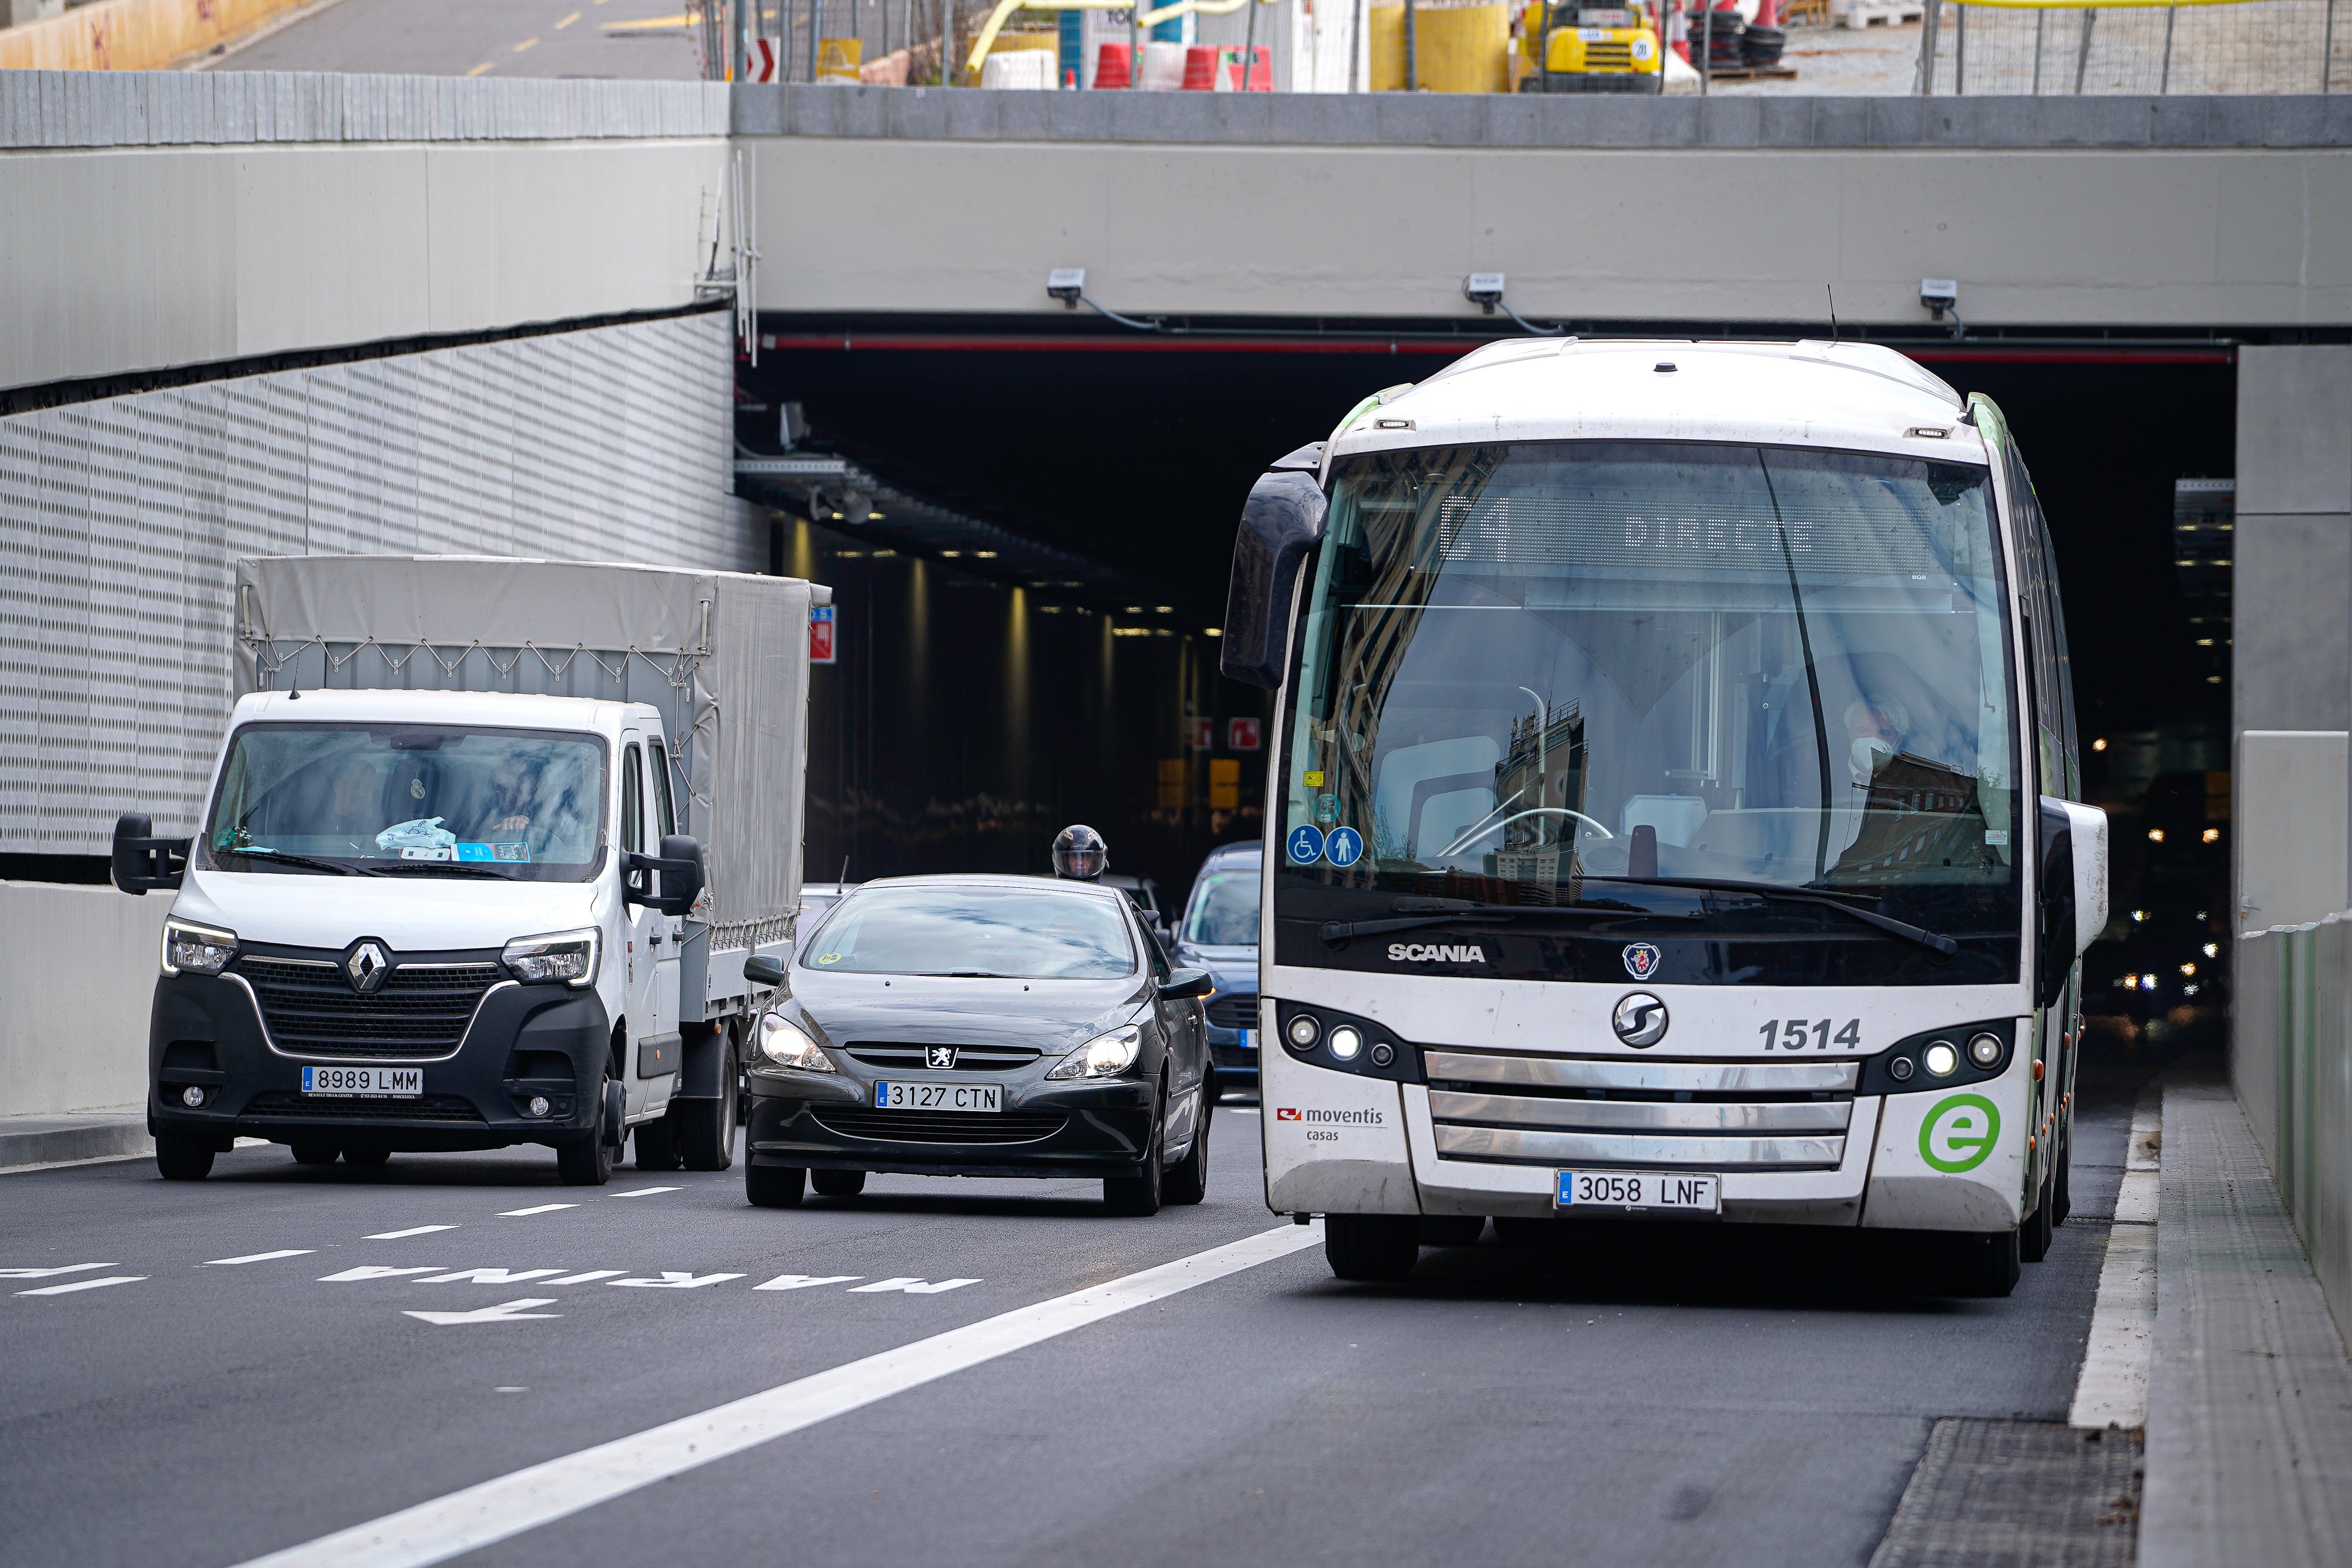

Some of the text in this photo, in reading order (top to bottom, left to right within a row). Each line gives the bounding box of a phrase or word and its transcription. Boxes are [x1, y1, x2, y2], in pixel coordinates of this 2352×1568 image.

[1625, 516, 1812, 551] DIRECTE
[1388, 943, 1486, 962] SCANIA
[1759, 1018, 1860, 1050] 1514
[318, 1070, 370, 1089] 8989
[379, 1071, 417, 1090] LMM
[892, 1086, 946, 1106] 3127
[956, 1088, 995, 1108] CTN
[1307, 1107, 1382, 1124] moventis
[1307, 1131, 1338, 1141] casas
[1562, 1176, 1708, 1204] E 3058 LNF
